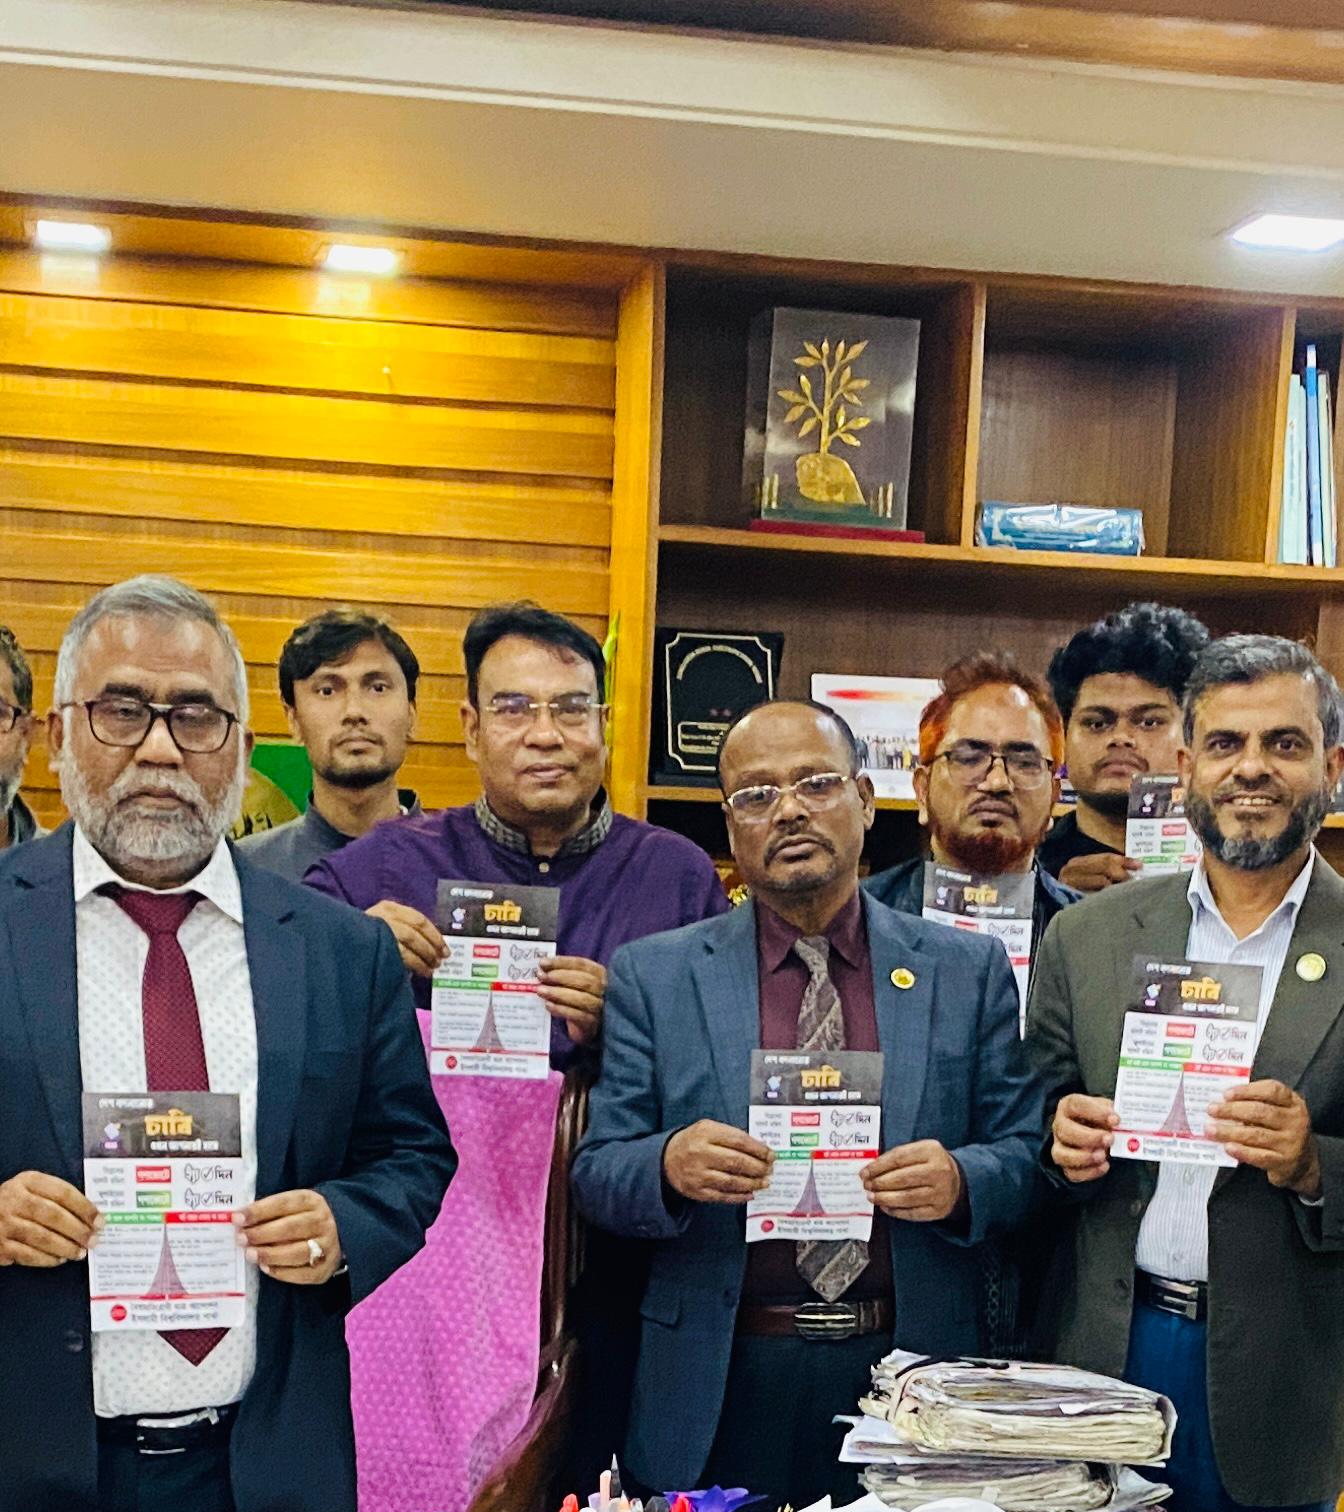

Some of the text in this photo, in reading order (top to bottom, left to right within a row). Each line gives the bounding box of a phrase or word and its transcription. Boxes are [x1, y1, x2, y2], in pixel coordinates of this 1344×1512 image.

[484, 900, 521, 922] চাবি
[1181, 976, 1221, 1001] চাবি
[801, 1065, 841, 1088] চাবি
[144, 1107, 193, 1136] চাবি
[215, 1166, 233, 1180] দিন
[215, 1191, 233, 1205] দিন
